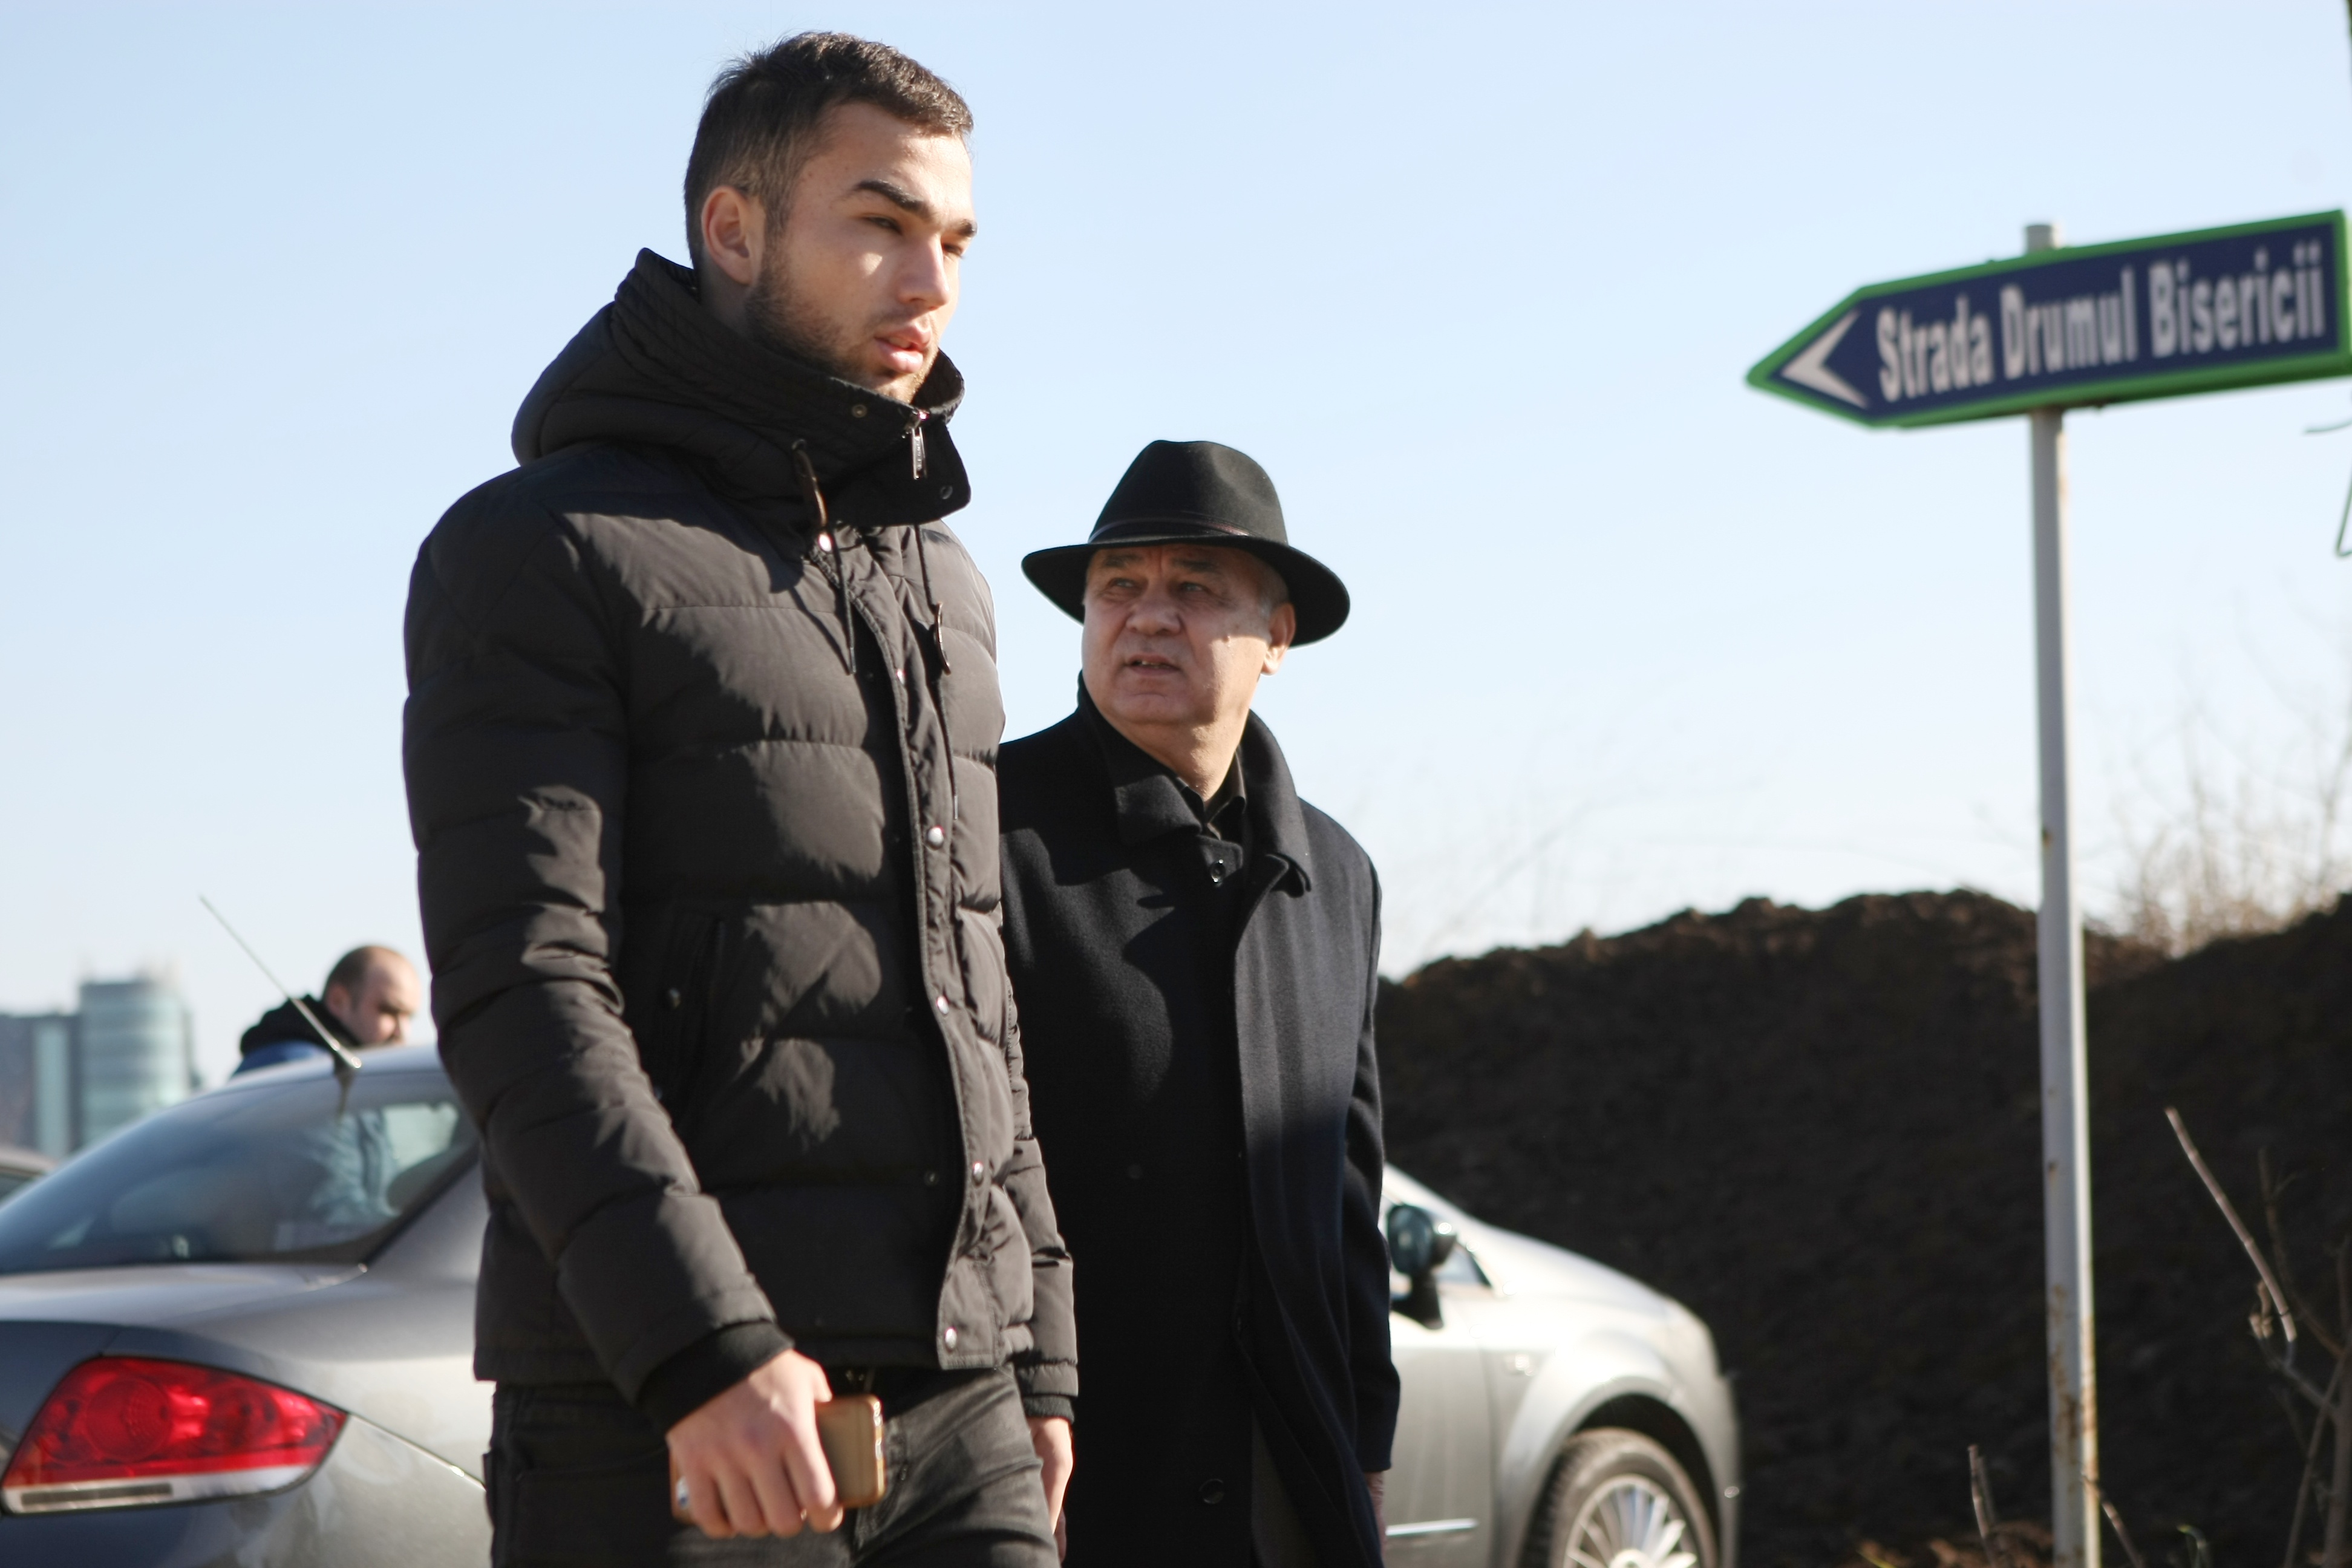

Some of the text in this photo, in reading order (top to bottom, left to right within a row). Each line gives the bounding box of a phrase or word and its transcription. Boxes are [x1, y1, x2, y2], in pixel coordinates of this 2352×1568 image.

[1876, 239, 2325, 402] Strada Drumul Bisericii
